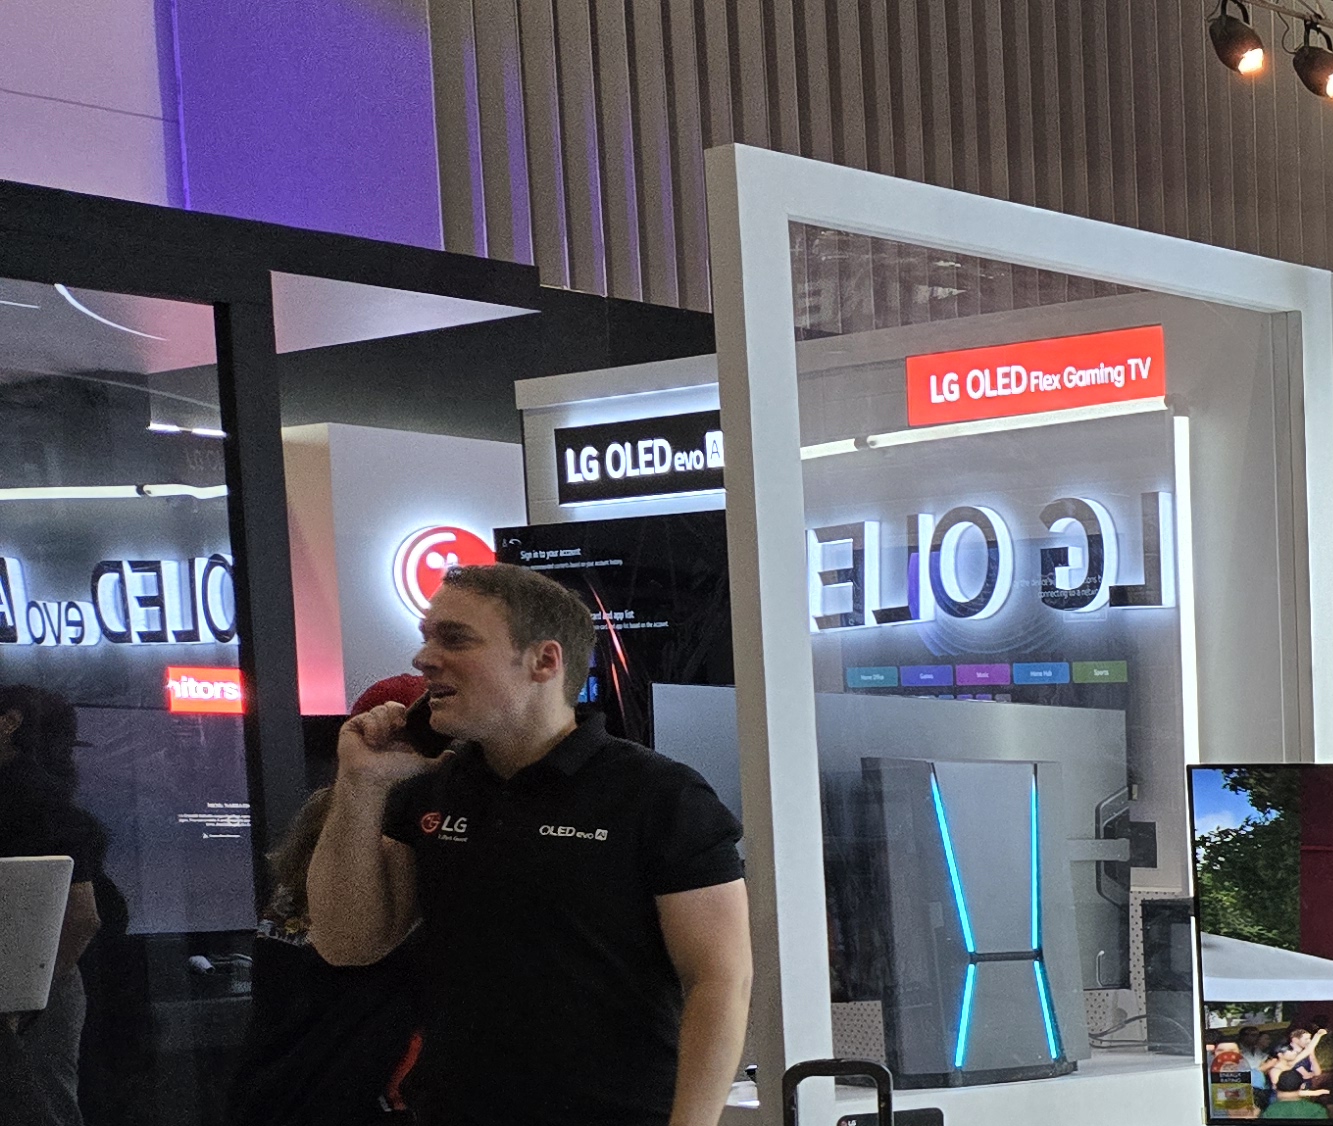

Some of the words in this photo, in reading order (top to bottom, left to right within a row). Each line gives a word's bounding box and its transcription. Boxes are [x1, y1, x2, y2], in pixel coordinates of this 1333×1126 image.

[930, 372, 960, 404] LG
[966, 365, 1028, 399] OLED
[1030, 370, 1062, 393] Flex
[1063, 362, 1125, 388] Gaming
[1127, 356, 1152, 381] TV
[566, 446, 600, 483] LG
[605, 438, 672, 479] OLED
[674, 450, 704, 471] evo
[441, 815, 467, 833] LG
[539, 825, 576, 837] OLED
[576, 832, 594, 840] evo
[847, 1119, 857, 1126] LG
